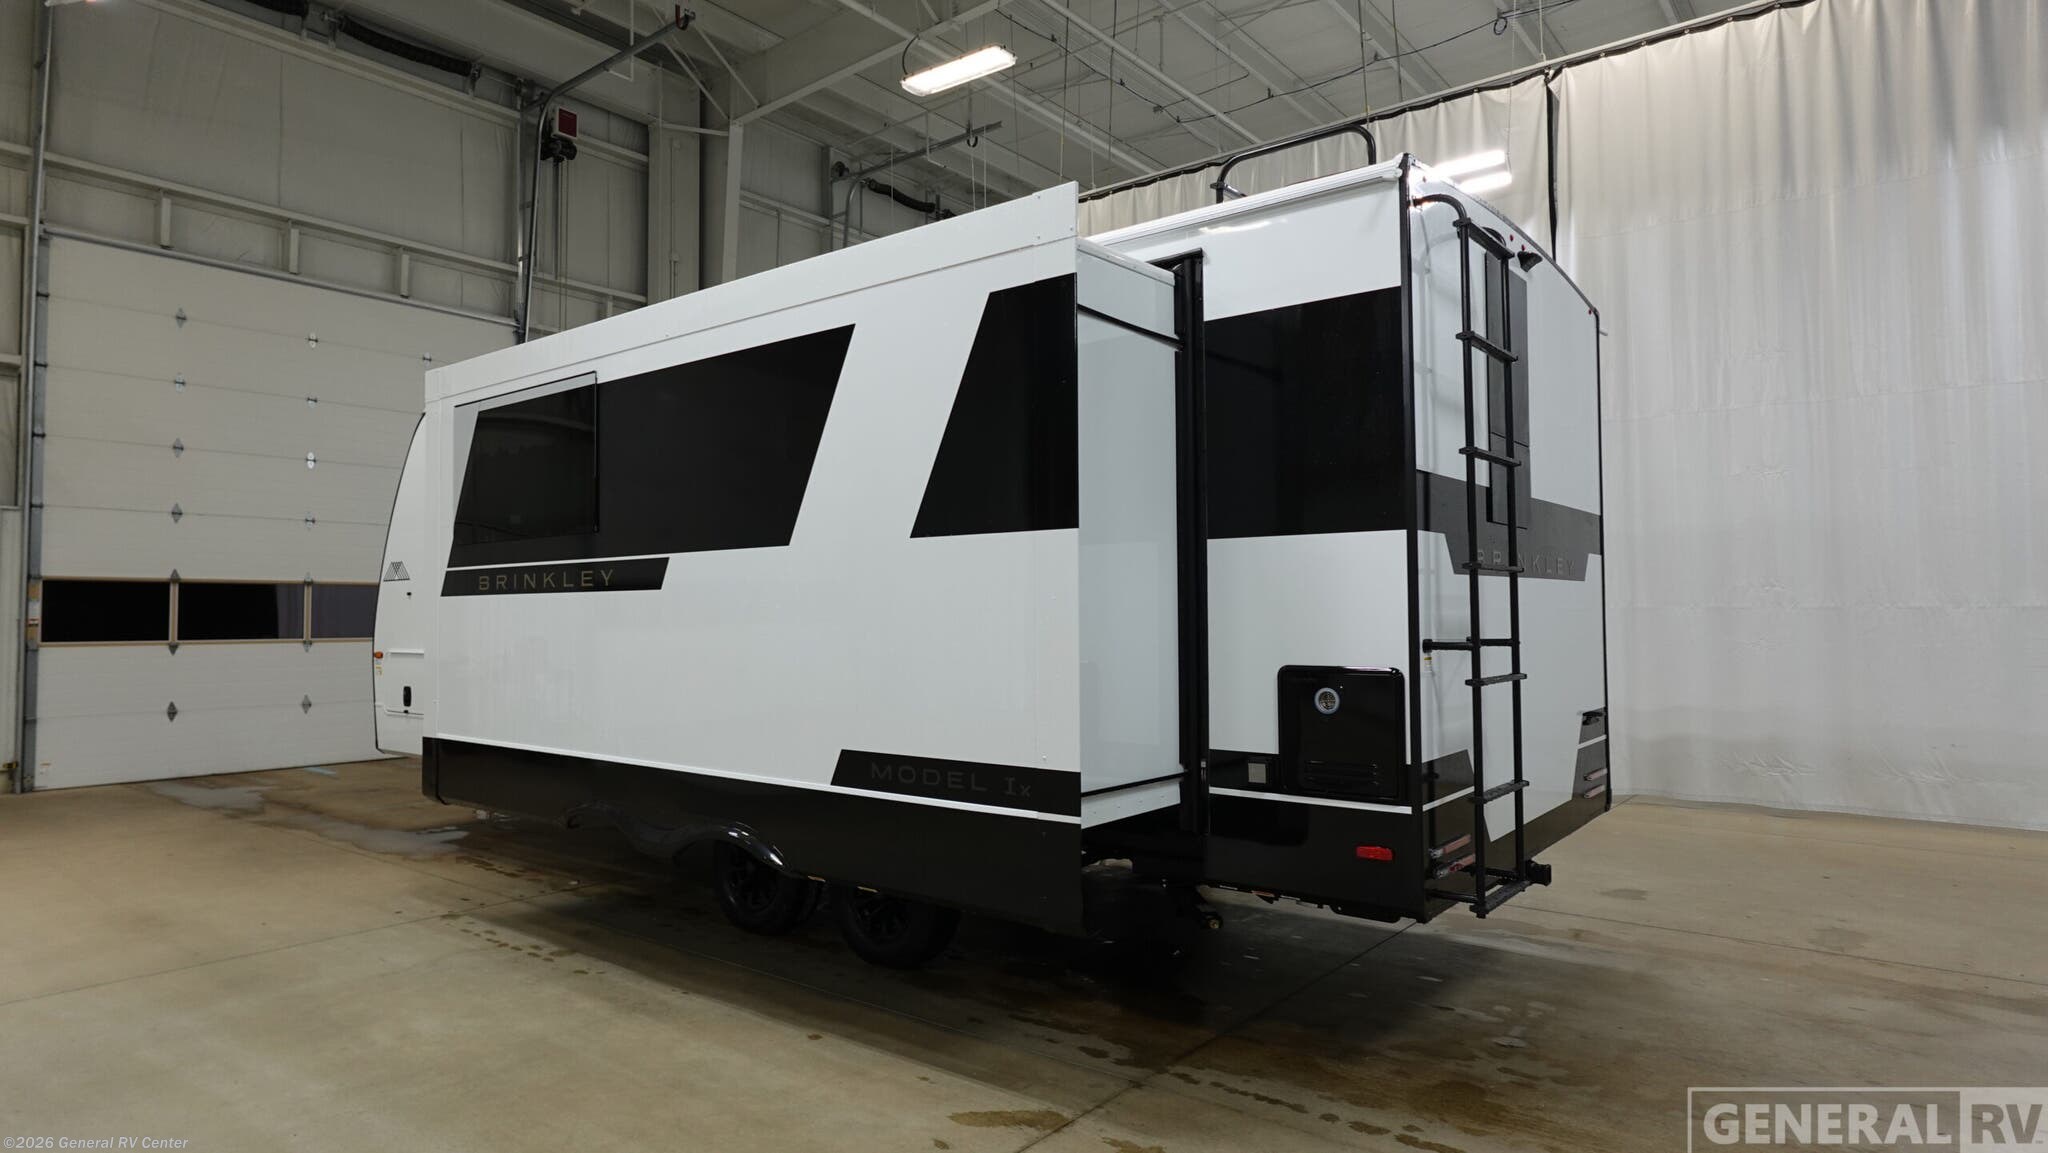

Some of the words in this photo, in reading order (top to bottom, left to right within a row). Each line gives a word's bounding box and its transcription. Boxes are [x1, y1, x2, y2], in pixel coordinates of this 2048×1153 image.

[1477, 548, 1576, 577] BRNKLEY
[478, 569, 614, 591] BRINKLEY
[871, 762, 988, 792] MODEL
